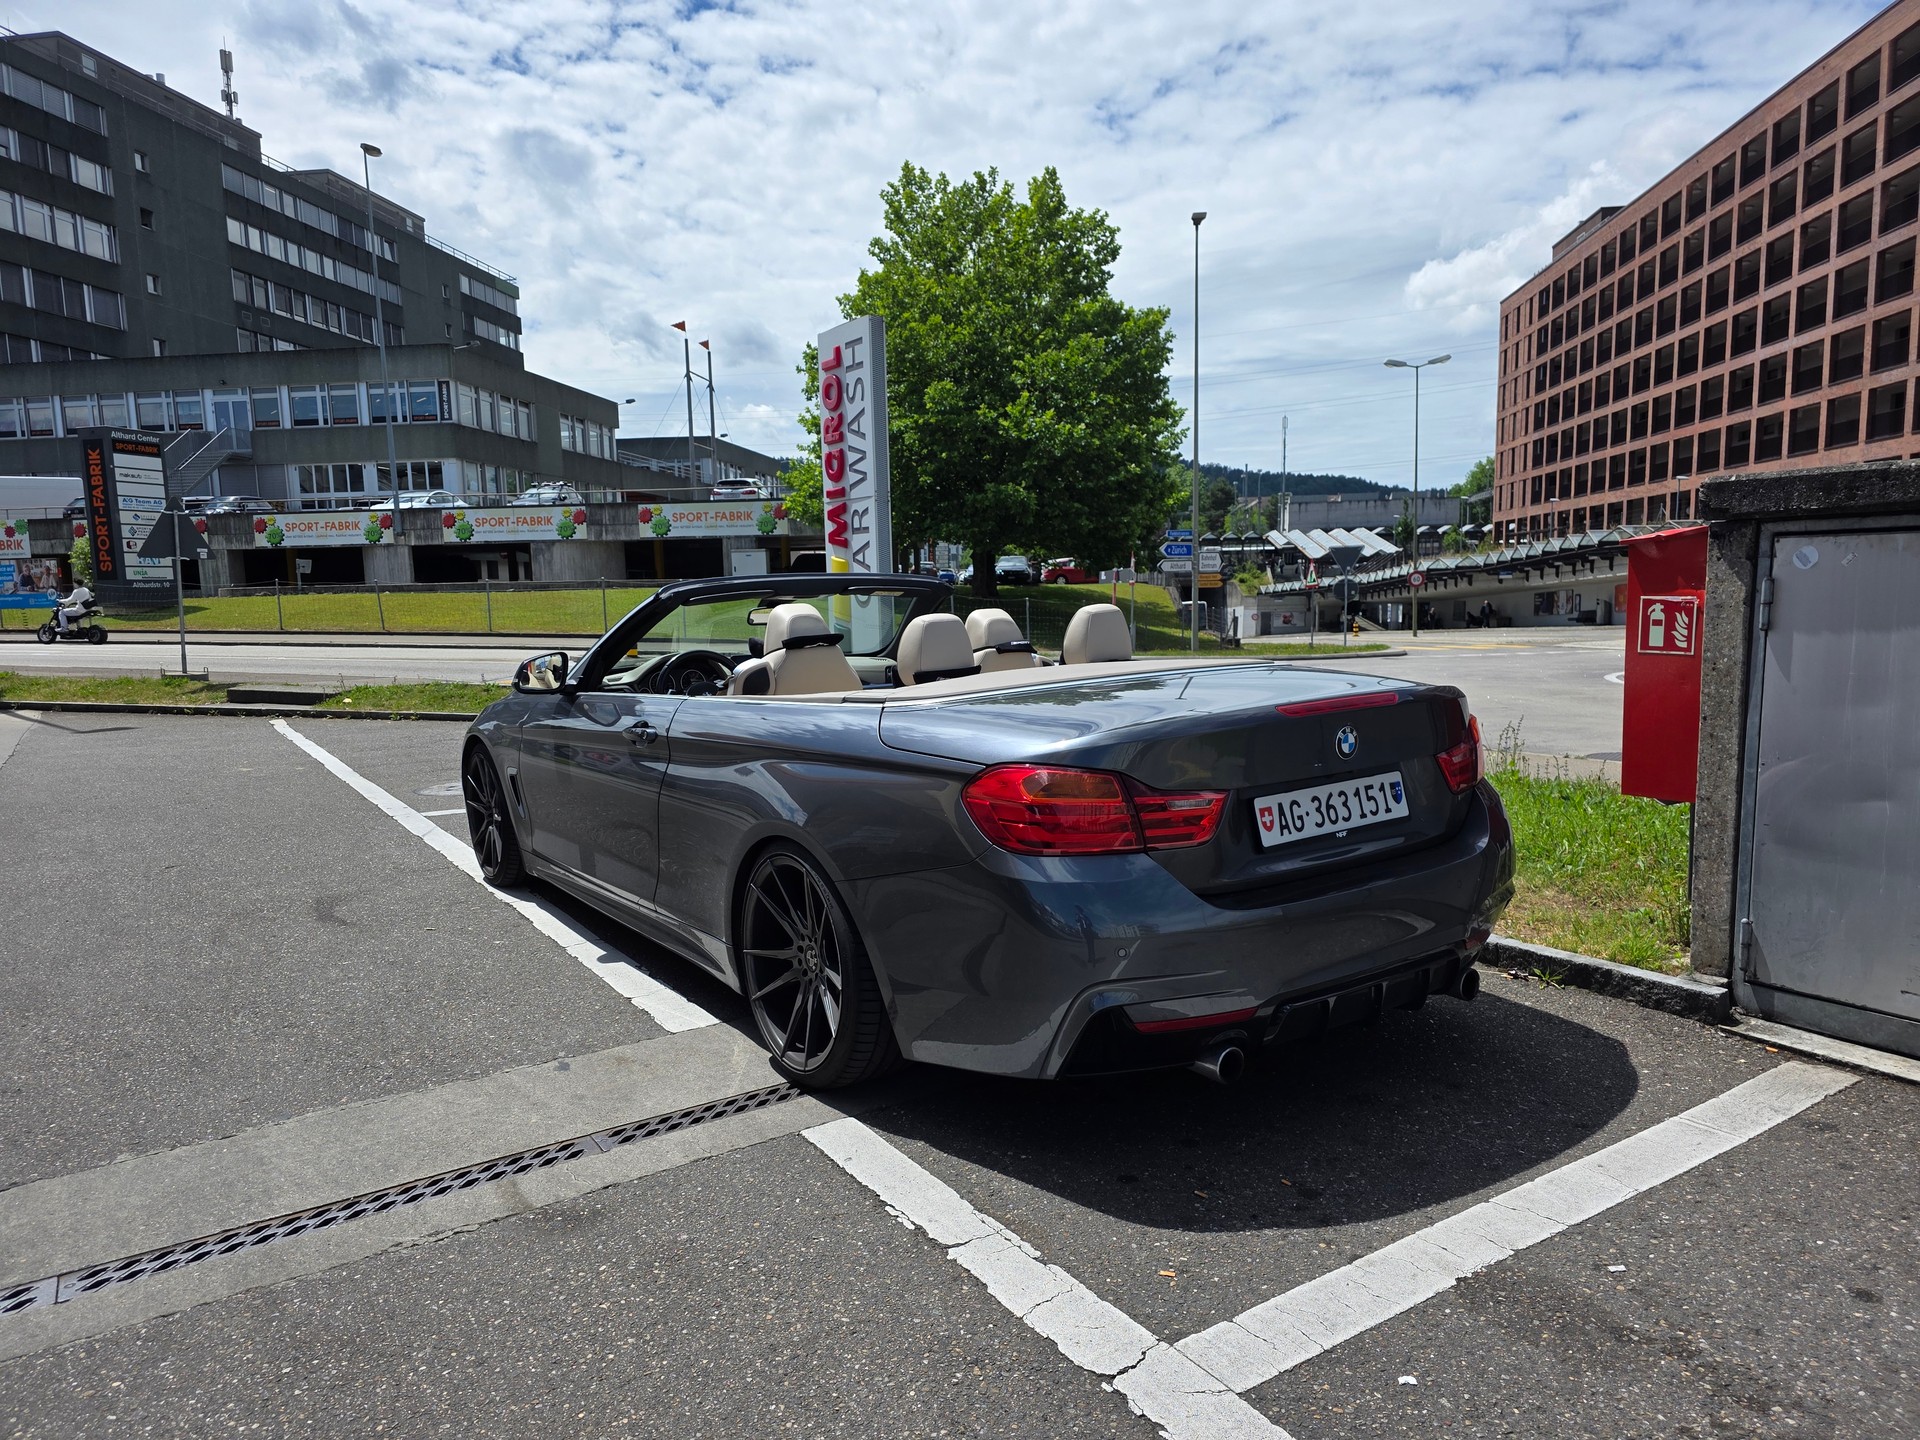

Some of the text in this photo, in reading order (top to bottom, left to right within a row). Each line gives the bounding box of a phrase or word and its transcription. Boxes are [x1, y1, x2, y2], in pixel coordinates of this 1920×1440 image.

[111, 431, 160, 443] Althard Center
[115, 443, 159, 454] SPORT-FABRIK
[821, 345, 849, 548] MIGROL
[87, 448, 113, 573] SPORT-FABRIK
[672, 510, 753, 523] SPORT-FABRIK
[284, 520, 361, 532] SPORT-FABRIK
[475, 516, 553, 527] SPORT-FABRIK
[1171, 545, 1188, 554] Zürich
[1412, 575, 1421, 583] 60
